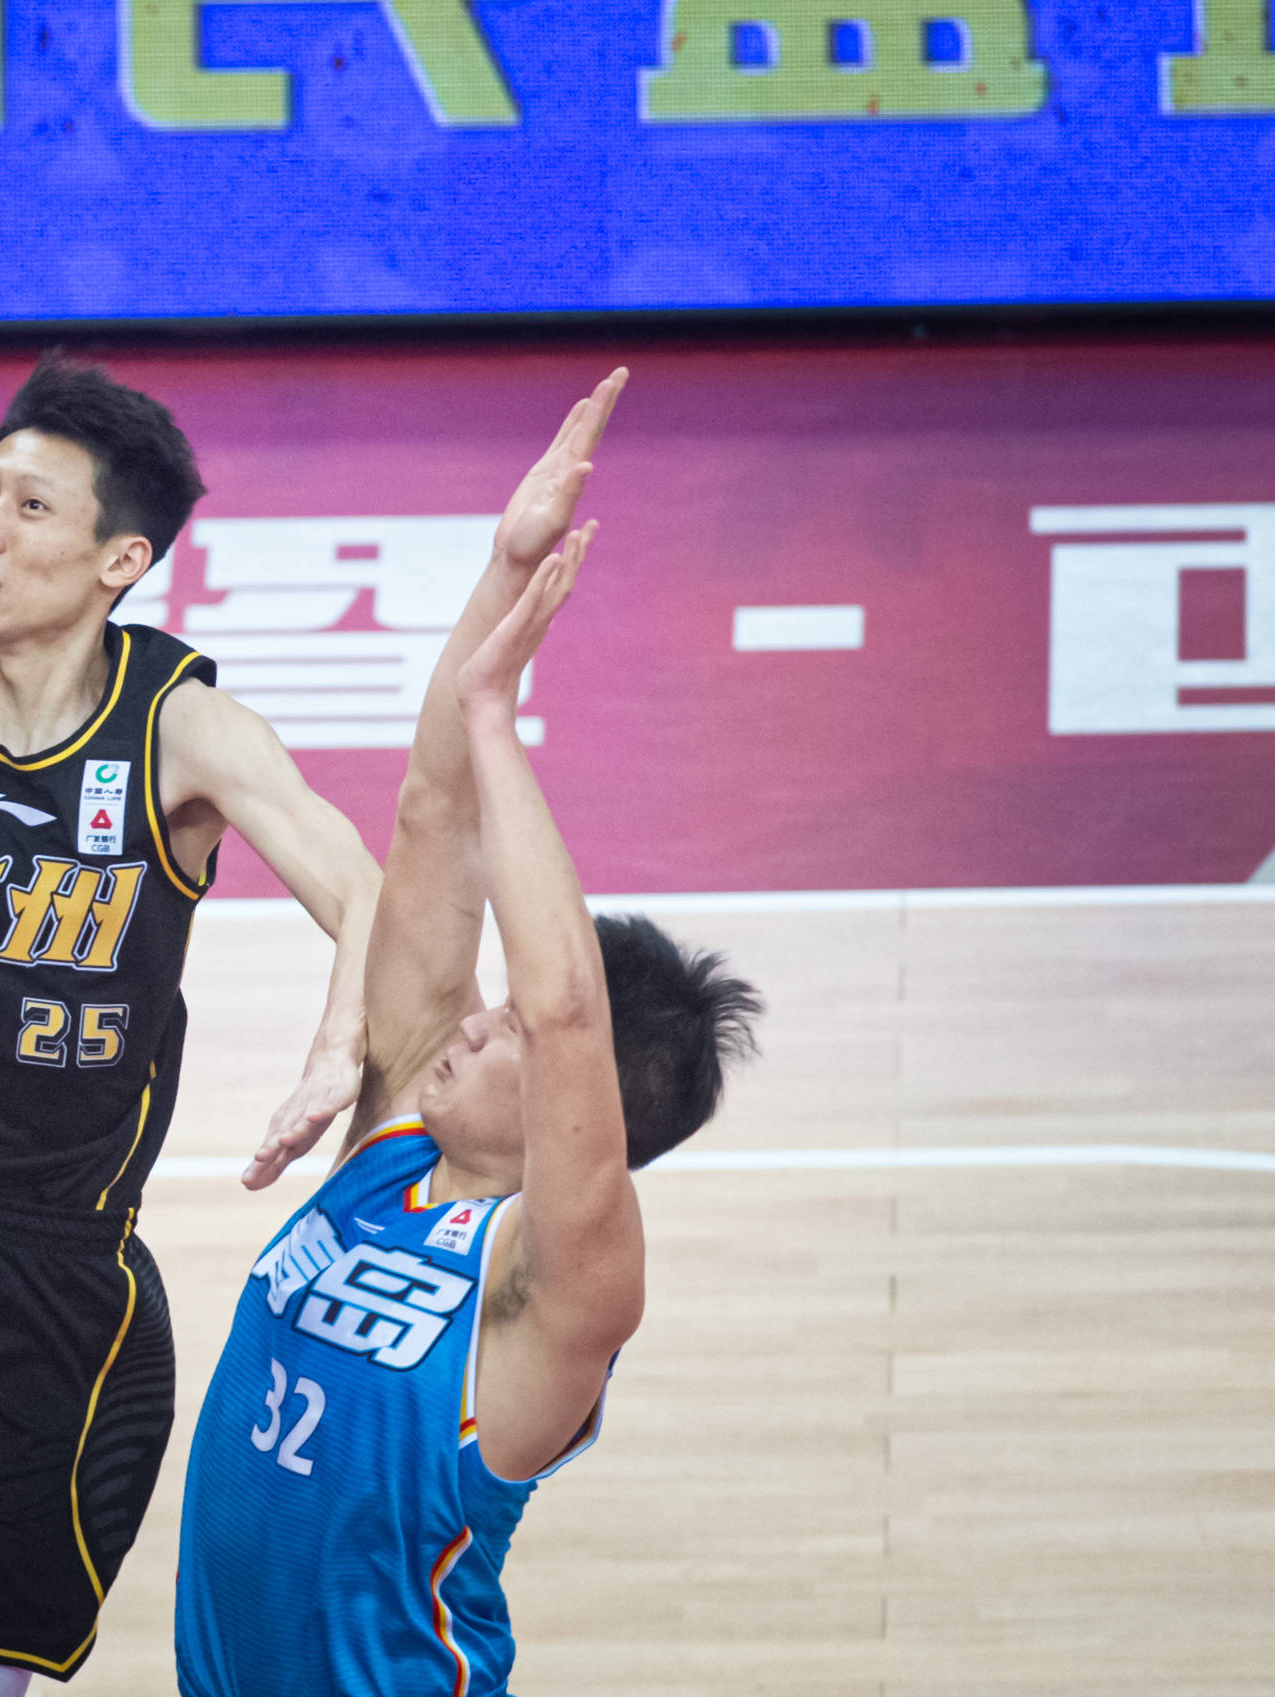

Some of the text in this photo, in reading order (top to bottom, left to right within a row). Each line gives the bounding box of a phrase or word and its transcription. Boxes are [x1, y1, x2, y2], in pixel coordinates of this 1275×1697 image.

[91, 844, 110, 853] CGB
[15, 997, 130, 1069] 25
[250, 1357, 327, 1477] 32
